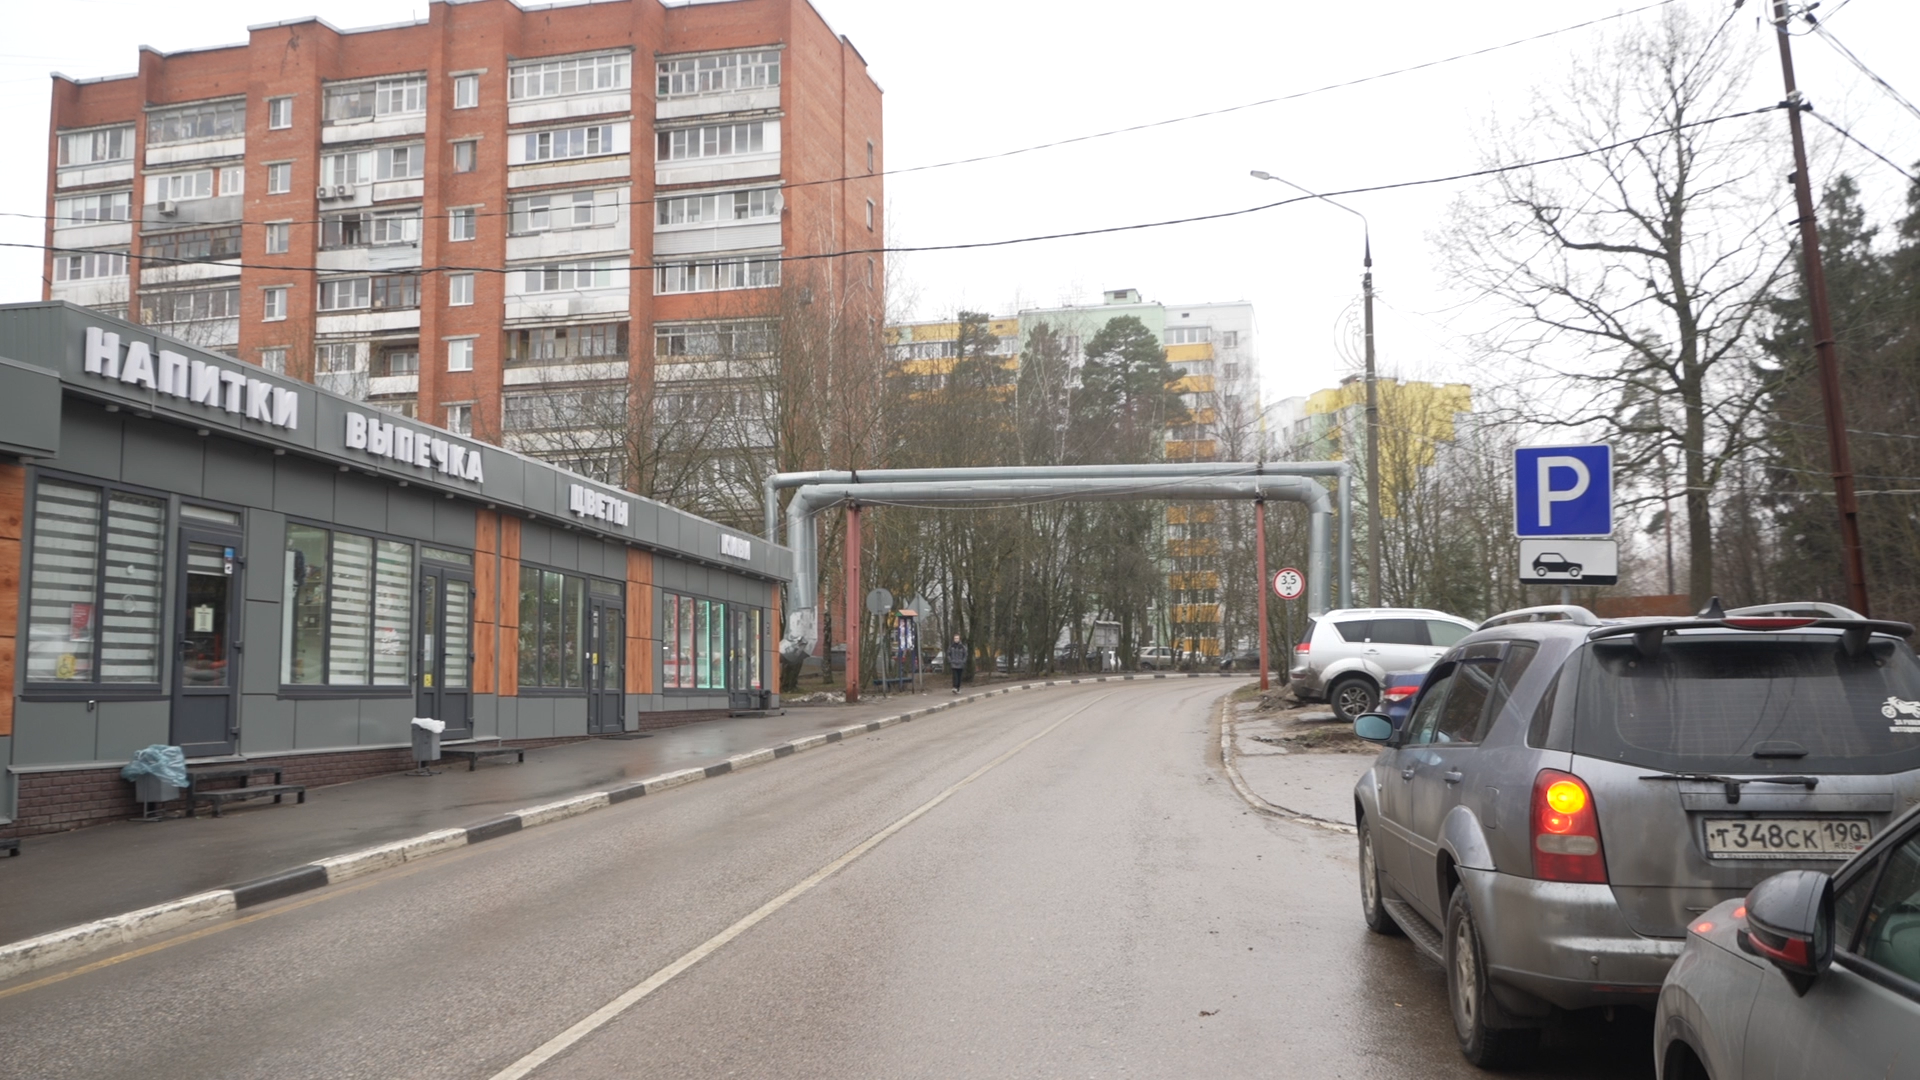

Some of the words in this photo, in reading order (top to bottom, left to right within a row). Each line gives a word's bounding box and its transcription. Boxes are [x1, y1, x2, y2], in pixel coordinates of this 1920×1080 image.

[85, 327, 298, 429] НАПИТКИ
[346, 412, 484, 483] ВЫПЕЧКА
[570, 484, 628, 526] ЦВЕТЫ
[1537, 456, 1591, 527] P
